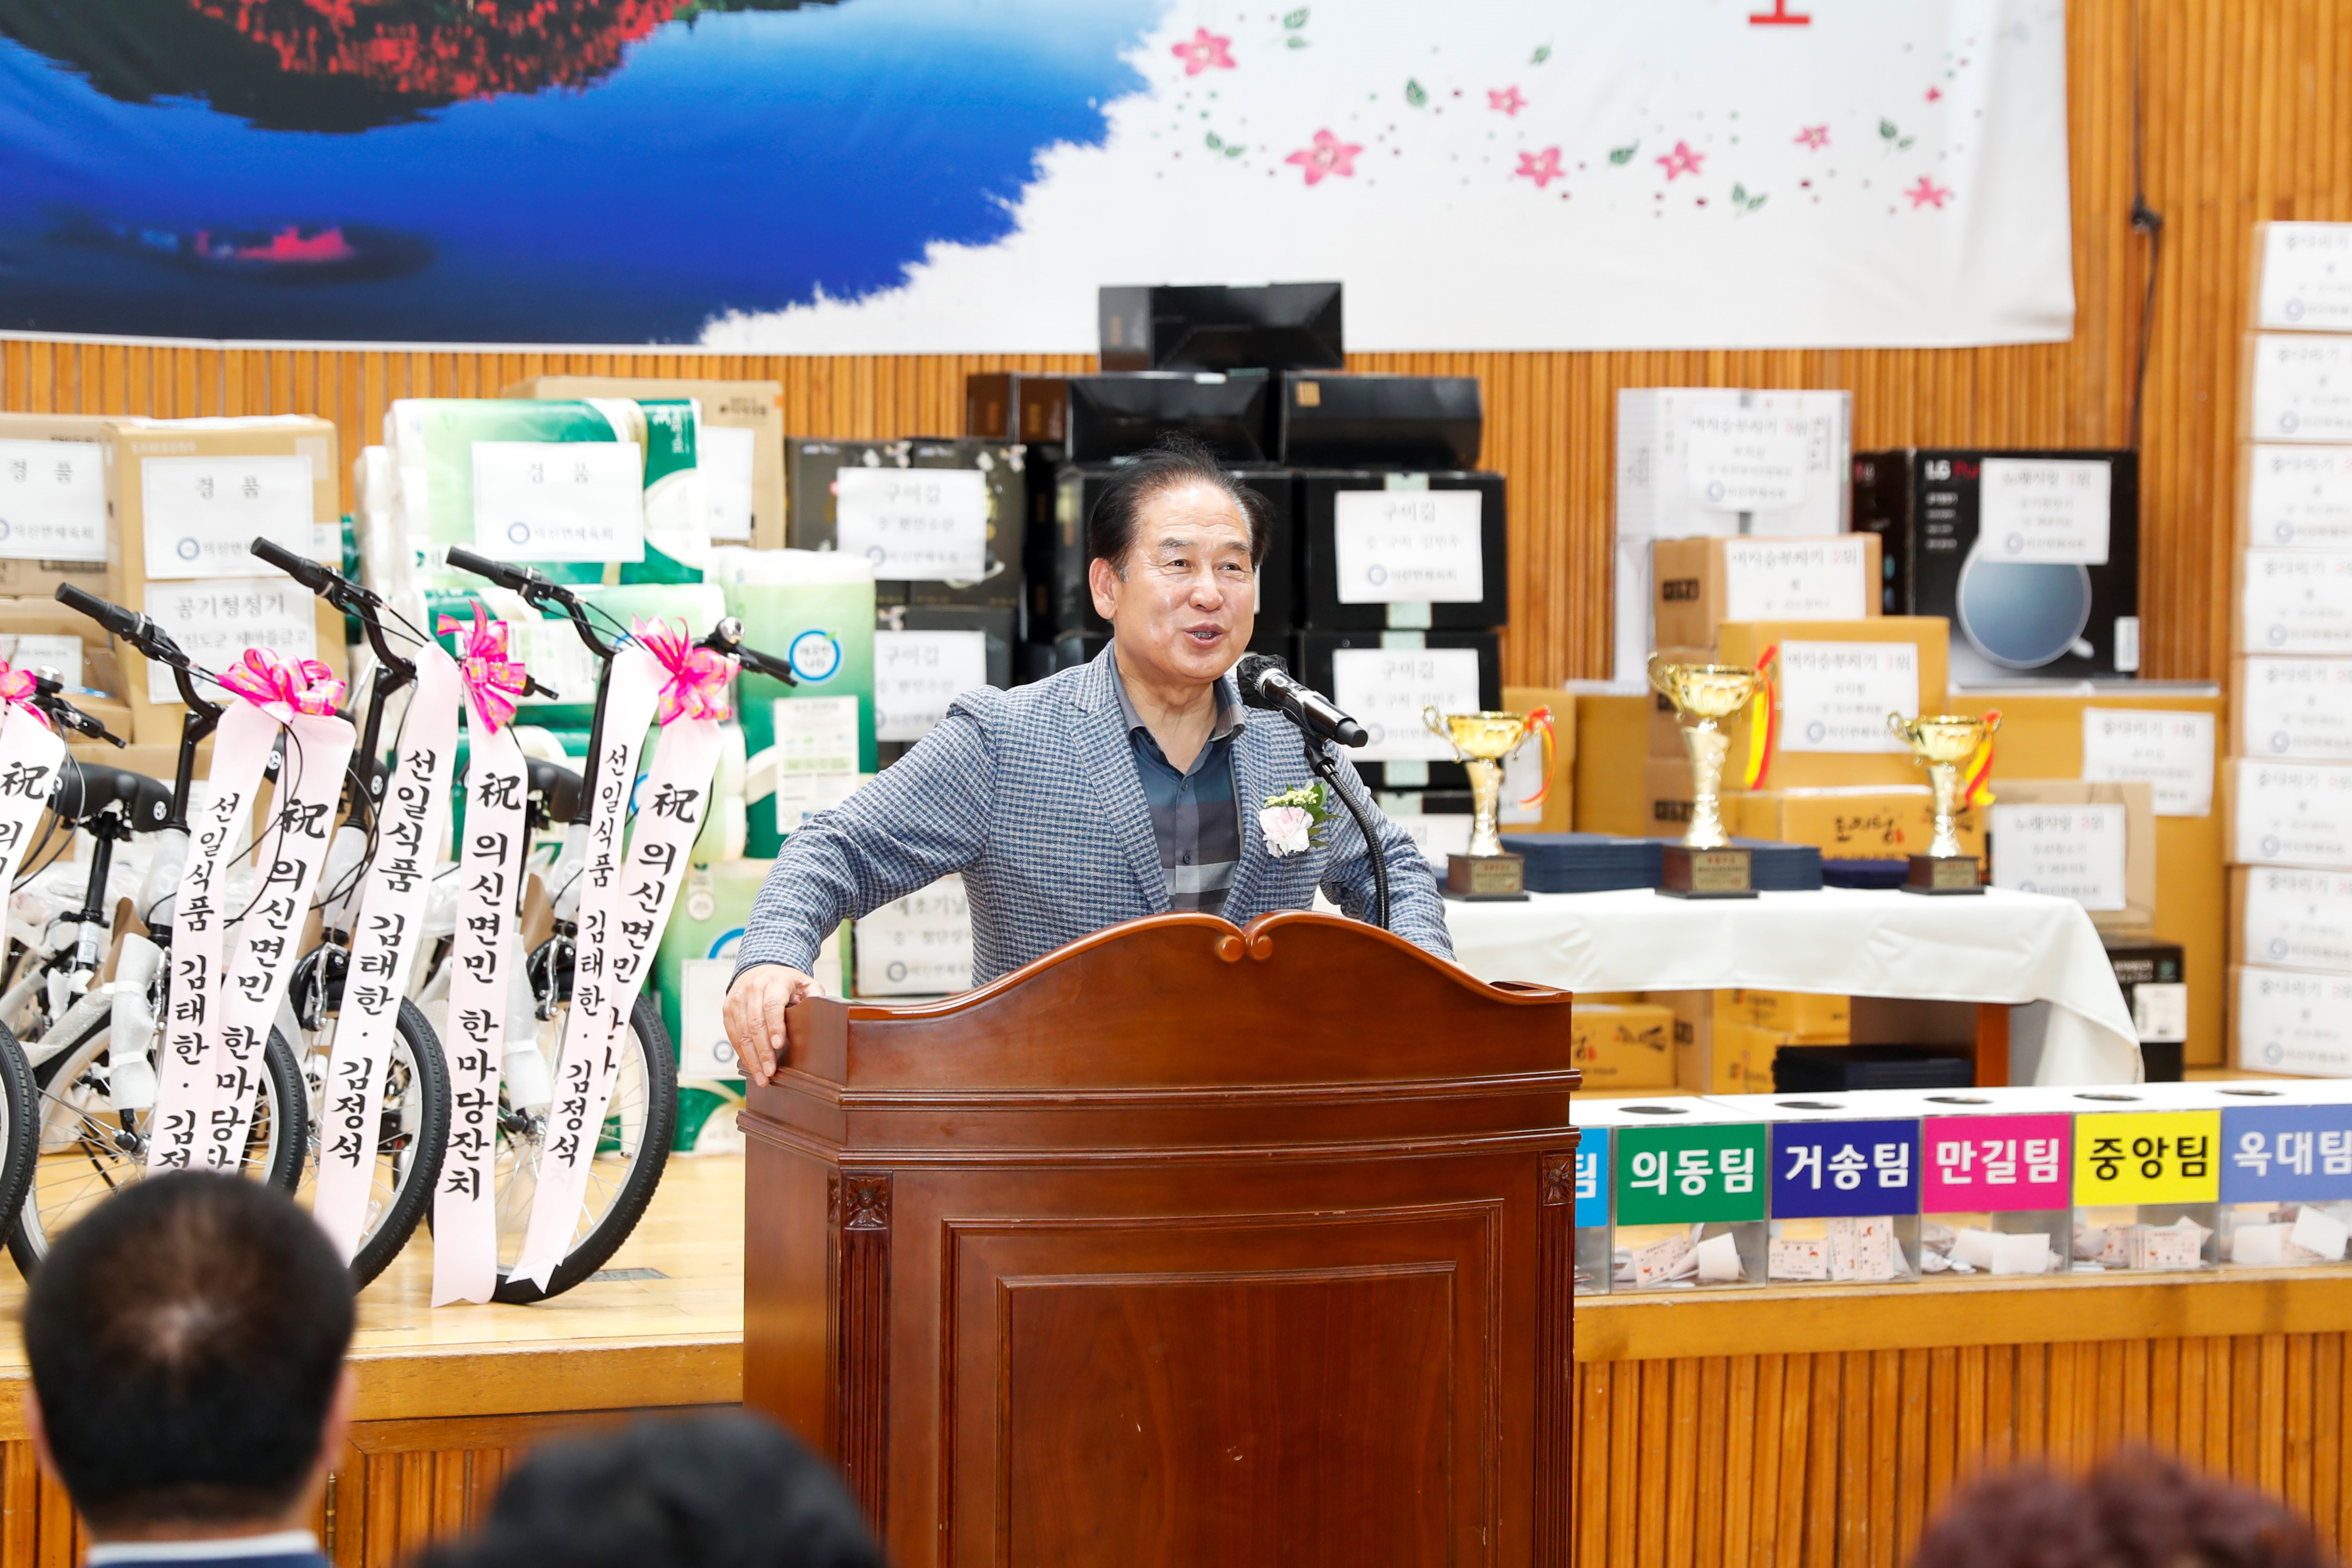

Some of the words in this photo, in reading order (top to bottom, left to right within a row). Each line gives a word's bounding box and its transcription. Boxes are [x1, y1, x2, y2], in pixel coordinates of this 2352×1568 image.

[1924, 459, 1951, 481] LG
[174, 592, 286, 622] 공기청정기
[236, 627, 308, 648] 새마을금고
[0, 761, 49, 799] 祝
[479, 773, 521, 810] 祝
[653, 784, 698, 822] 祝
[278, 799, 329, 839] 祝
[378, 749, 437, 892] 선일식품
[588, 744, 629, 888] 선일식품
[179, 793, 240, 932] 선일식품
[463, 830, 507, 983] 의신면민
[612, 842, 677, 984] 의신면민
[238, 858, 307, 1003] 의신면민
[353, 913, 406, 1016] 김태한
[575, 908, 605, 1016] 김태한
[170, 953, 209, 1065] 김태한
[329, 1058, 372, 1167] 김정석
[444, 1008, 499, 1201] 한마당잔치
[550, 1060, 591, 1167] 김정석
[1576, 1152, 1598, 1199] 팀
[1631, 1148, 1753, 1195] 의동팀
[1787, 1143, 1909, 1189] 거송팀
[1938, 1139, 2058, 1184] 만길팀
[2090, 1136, 2207, 1181] 중앙팀
[2234, 1131, 2352, 1176] 옥대팀
